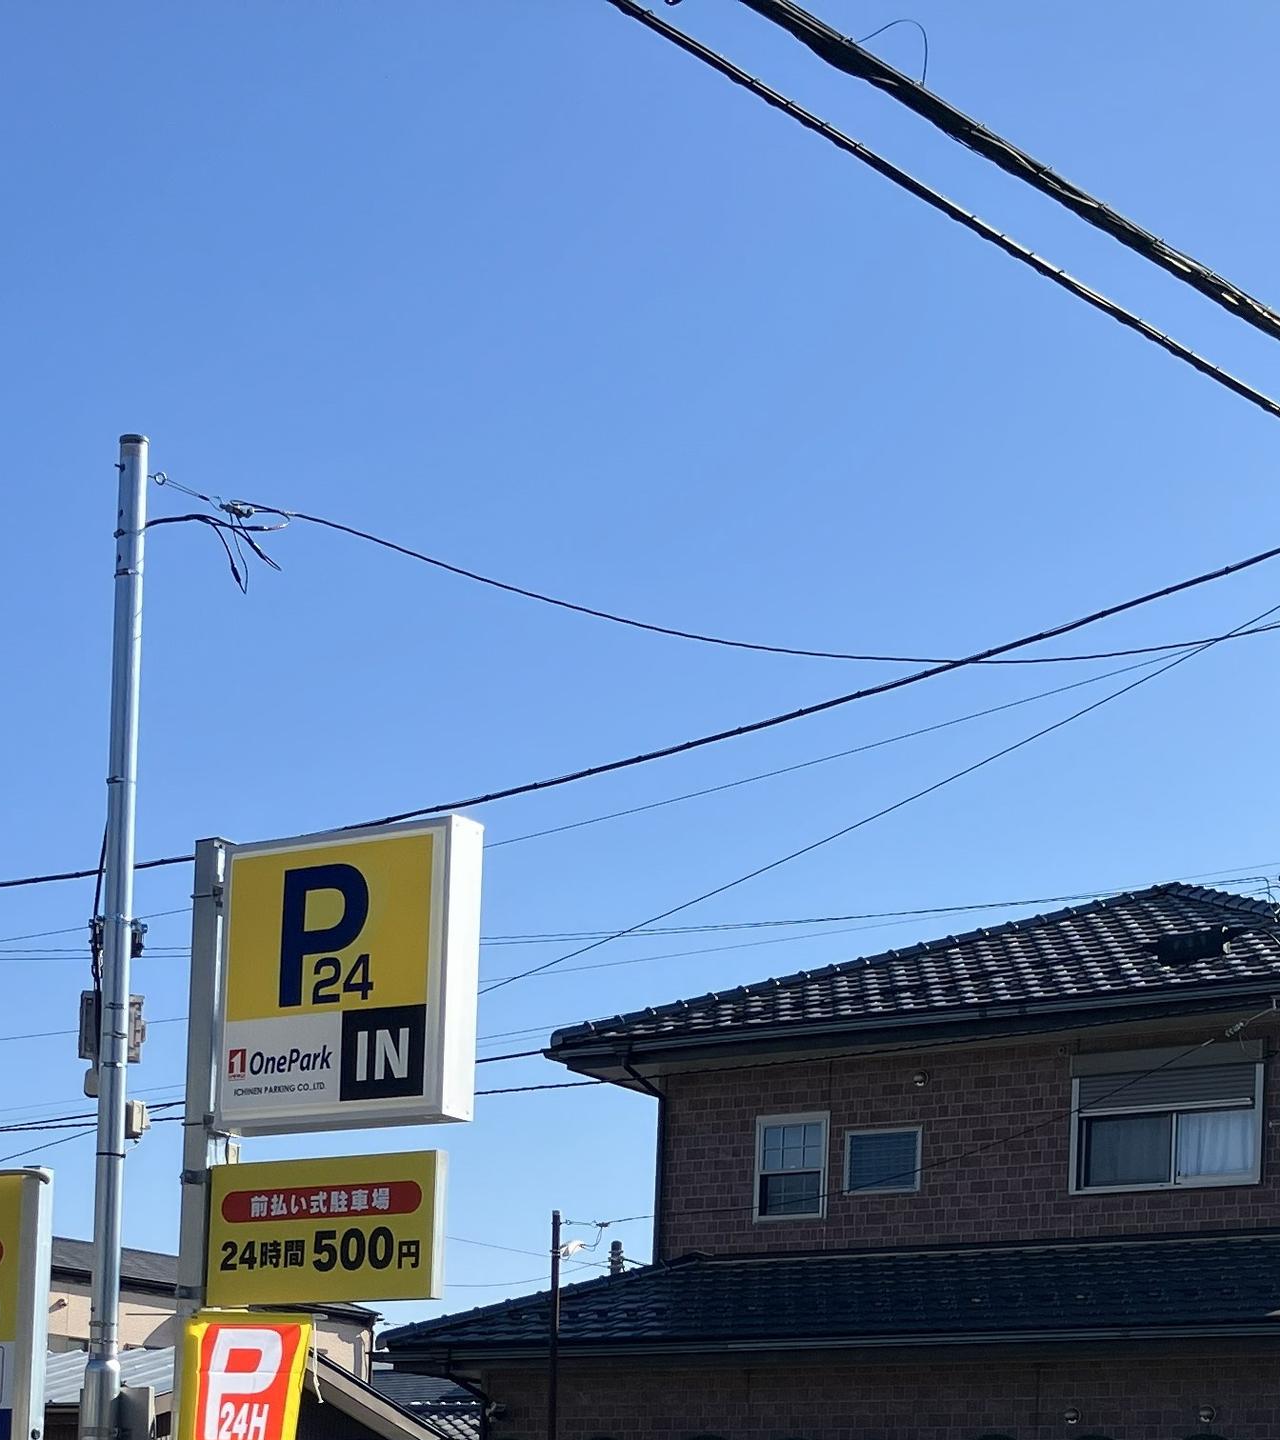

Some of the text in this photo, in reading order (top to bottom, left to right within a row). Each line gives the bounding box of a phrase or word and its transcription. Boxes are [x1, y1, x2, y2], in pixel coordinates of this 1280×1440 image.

[279, 863, 369, 1008] P
[312, 953, 373, 1005] 24
[250, 1045, 333, 1075] OnePark
[356, 1027, 409, 1082] IN
[234, 1087, 262, 1096] ICHINEN
[264, 1084, 296, 1093] PARKING
[250, 1188, 390, 1217] 前払い式駐車場
[220, 1226, 420, 1272] 24時間 500円
[204, 1328, 283, 1440] P
